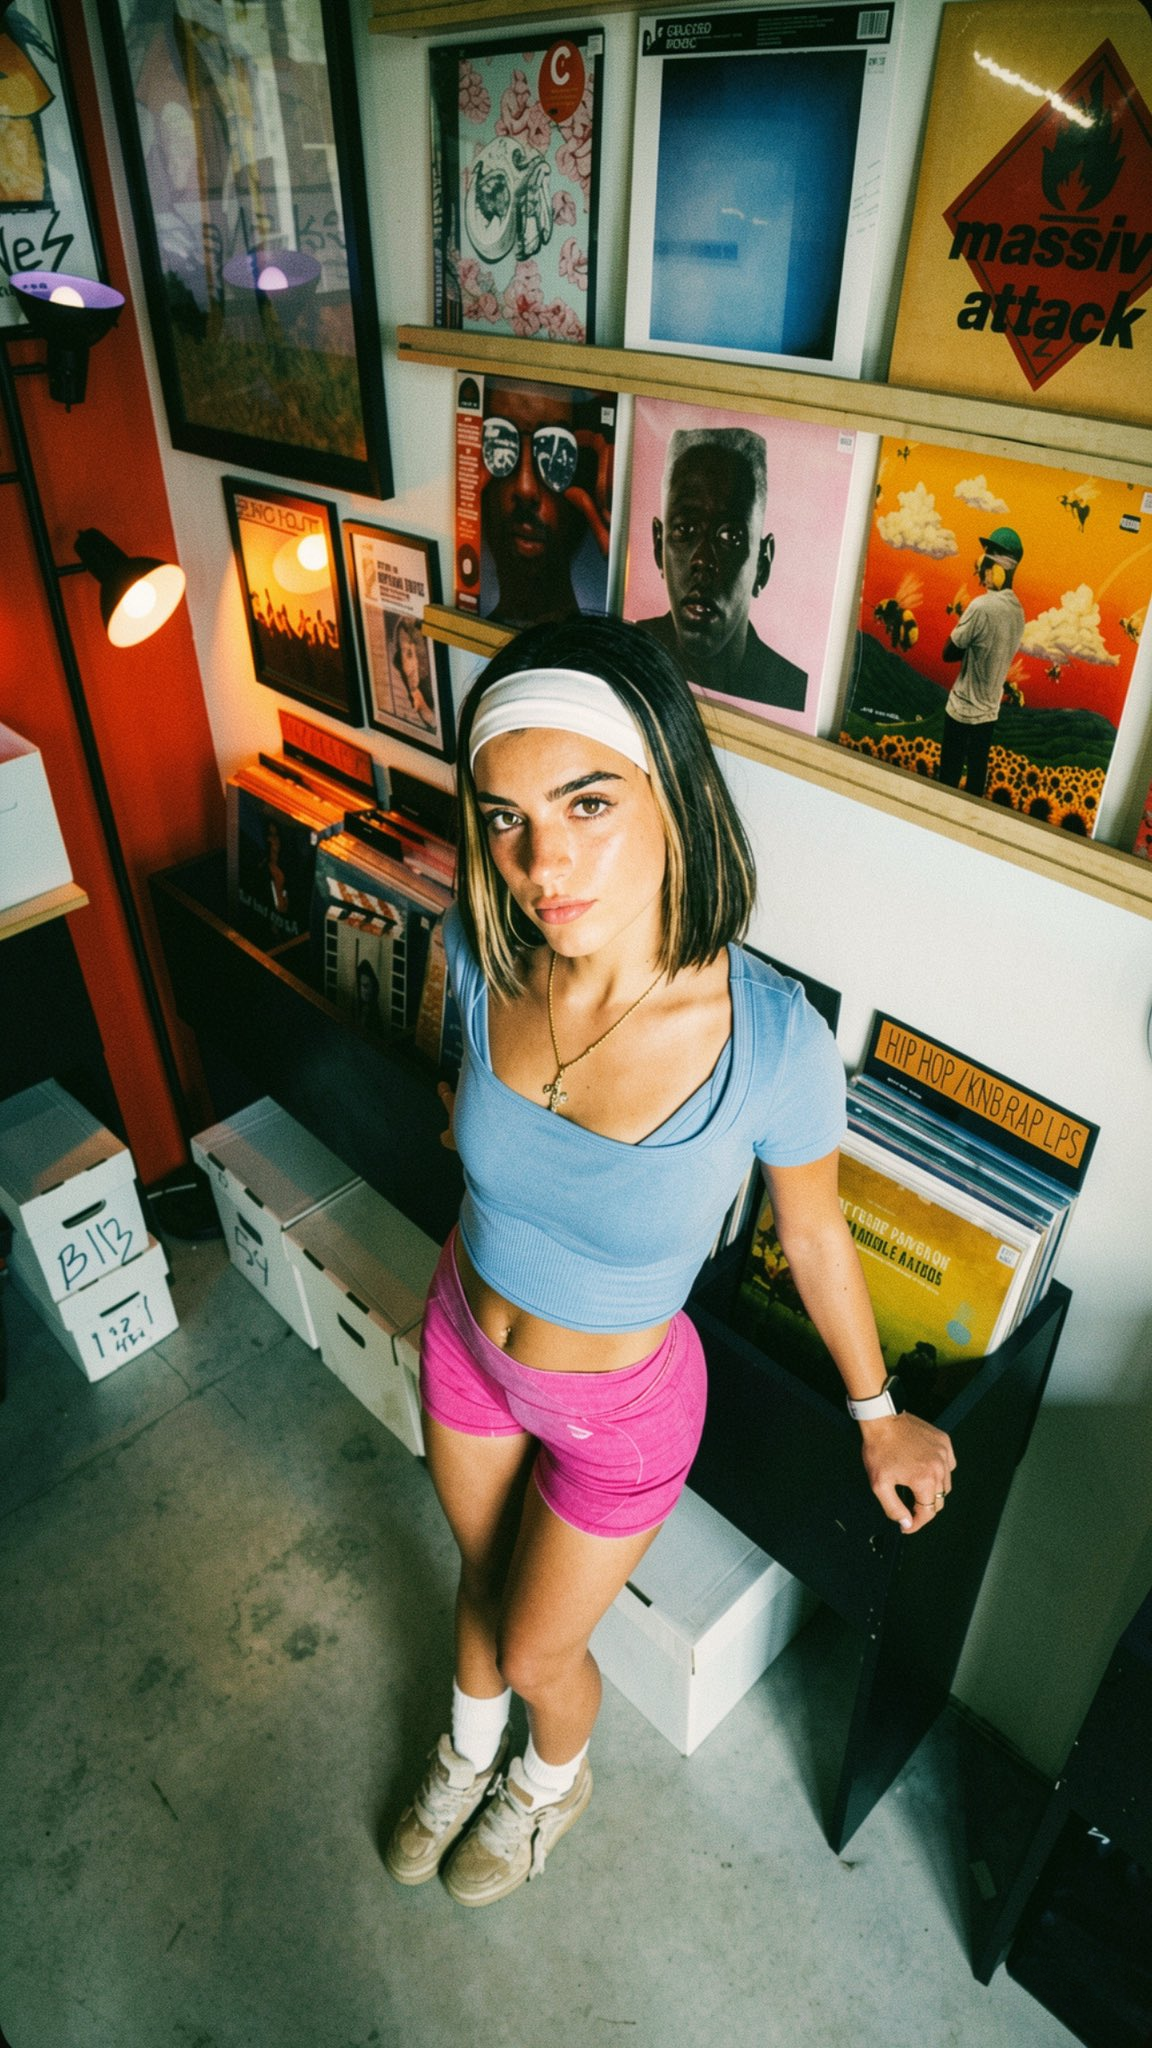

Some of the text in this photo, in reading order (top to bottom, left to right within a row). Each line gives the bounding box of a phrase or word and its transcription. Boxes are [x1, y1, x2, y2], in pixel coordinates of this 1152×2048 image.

[957, 283, 1147, 349] attack
[885, 1028, 917, 1069] HIP
[917, 1045, 955, 1089] HOP
[1043, 1116, 1082, 1160] LPS
